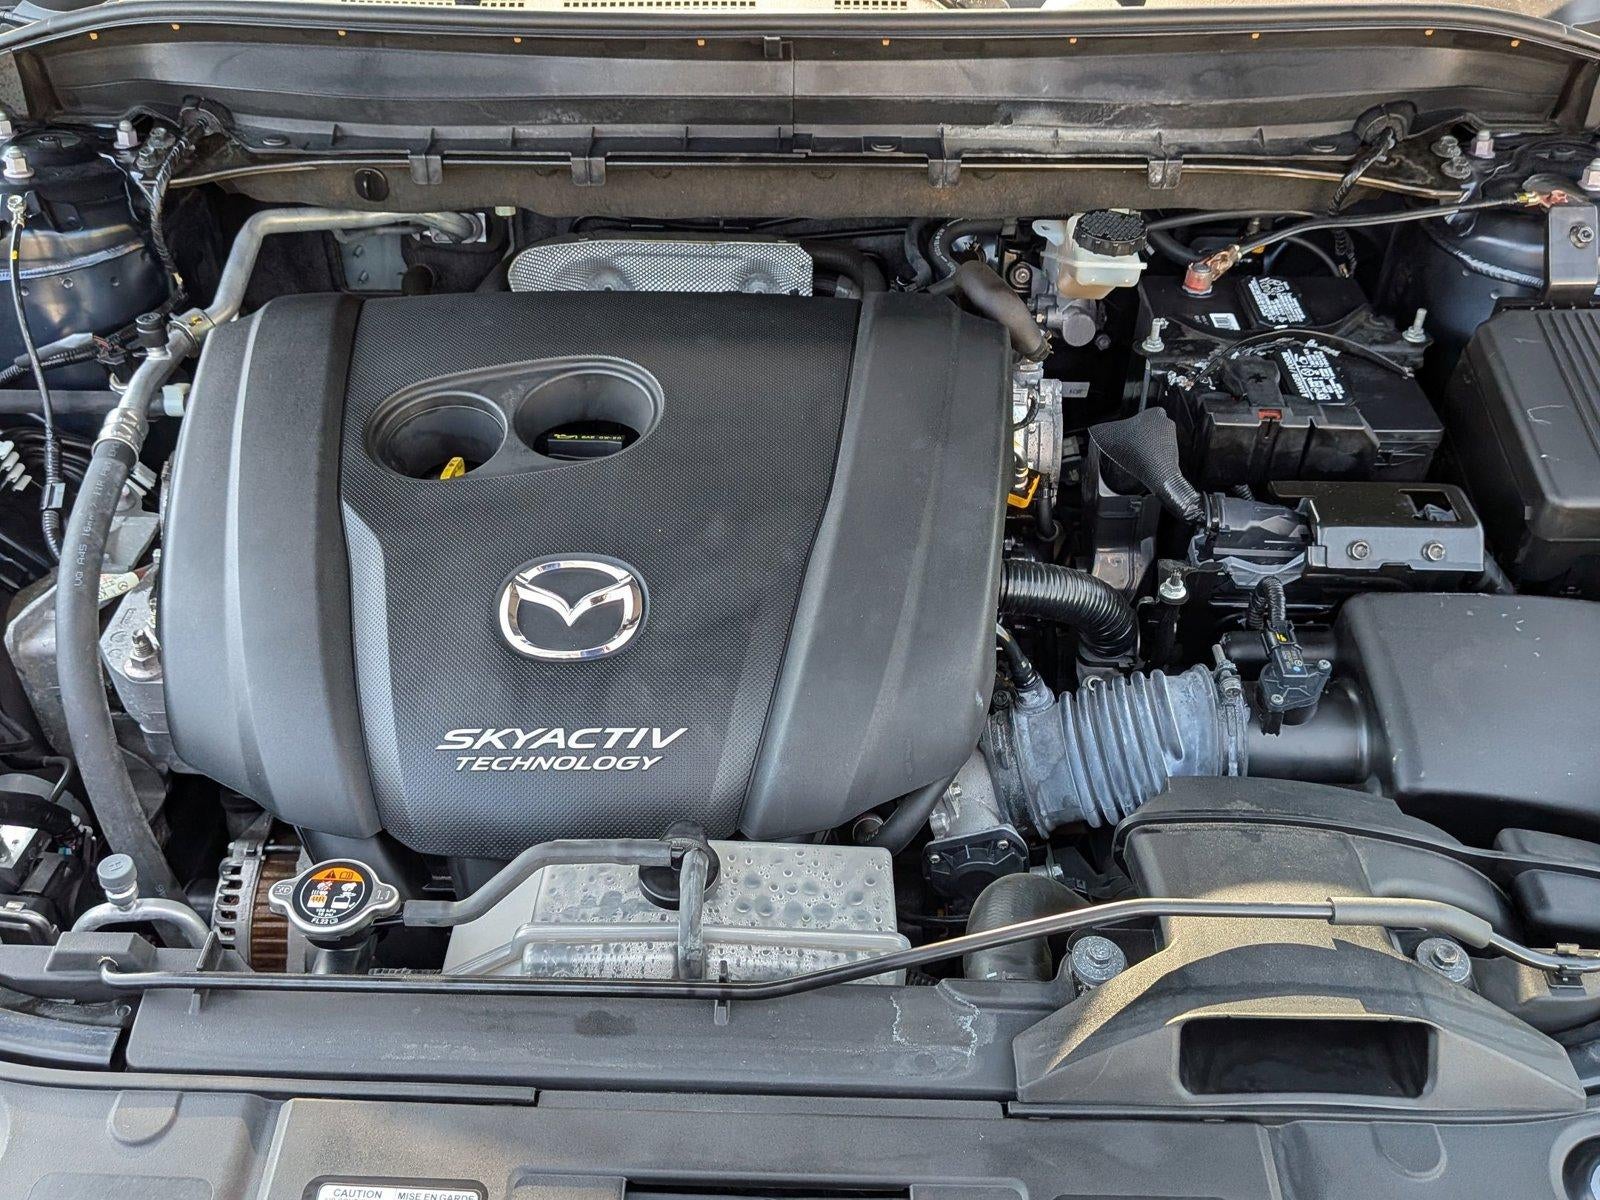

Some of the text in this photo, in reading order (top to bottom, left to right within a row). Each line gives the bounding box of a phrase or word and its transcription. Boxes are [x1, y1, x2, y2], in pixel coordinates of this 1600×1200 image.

[435, 726, 689, 750] SKYACTIV
[454, 755, 663, 771] TECHNOLOGY
[333, 1188, 383, 1199] CAUTION
[397, 1192, 422, 1200] MISE
